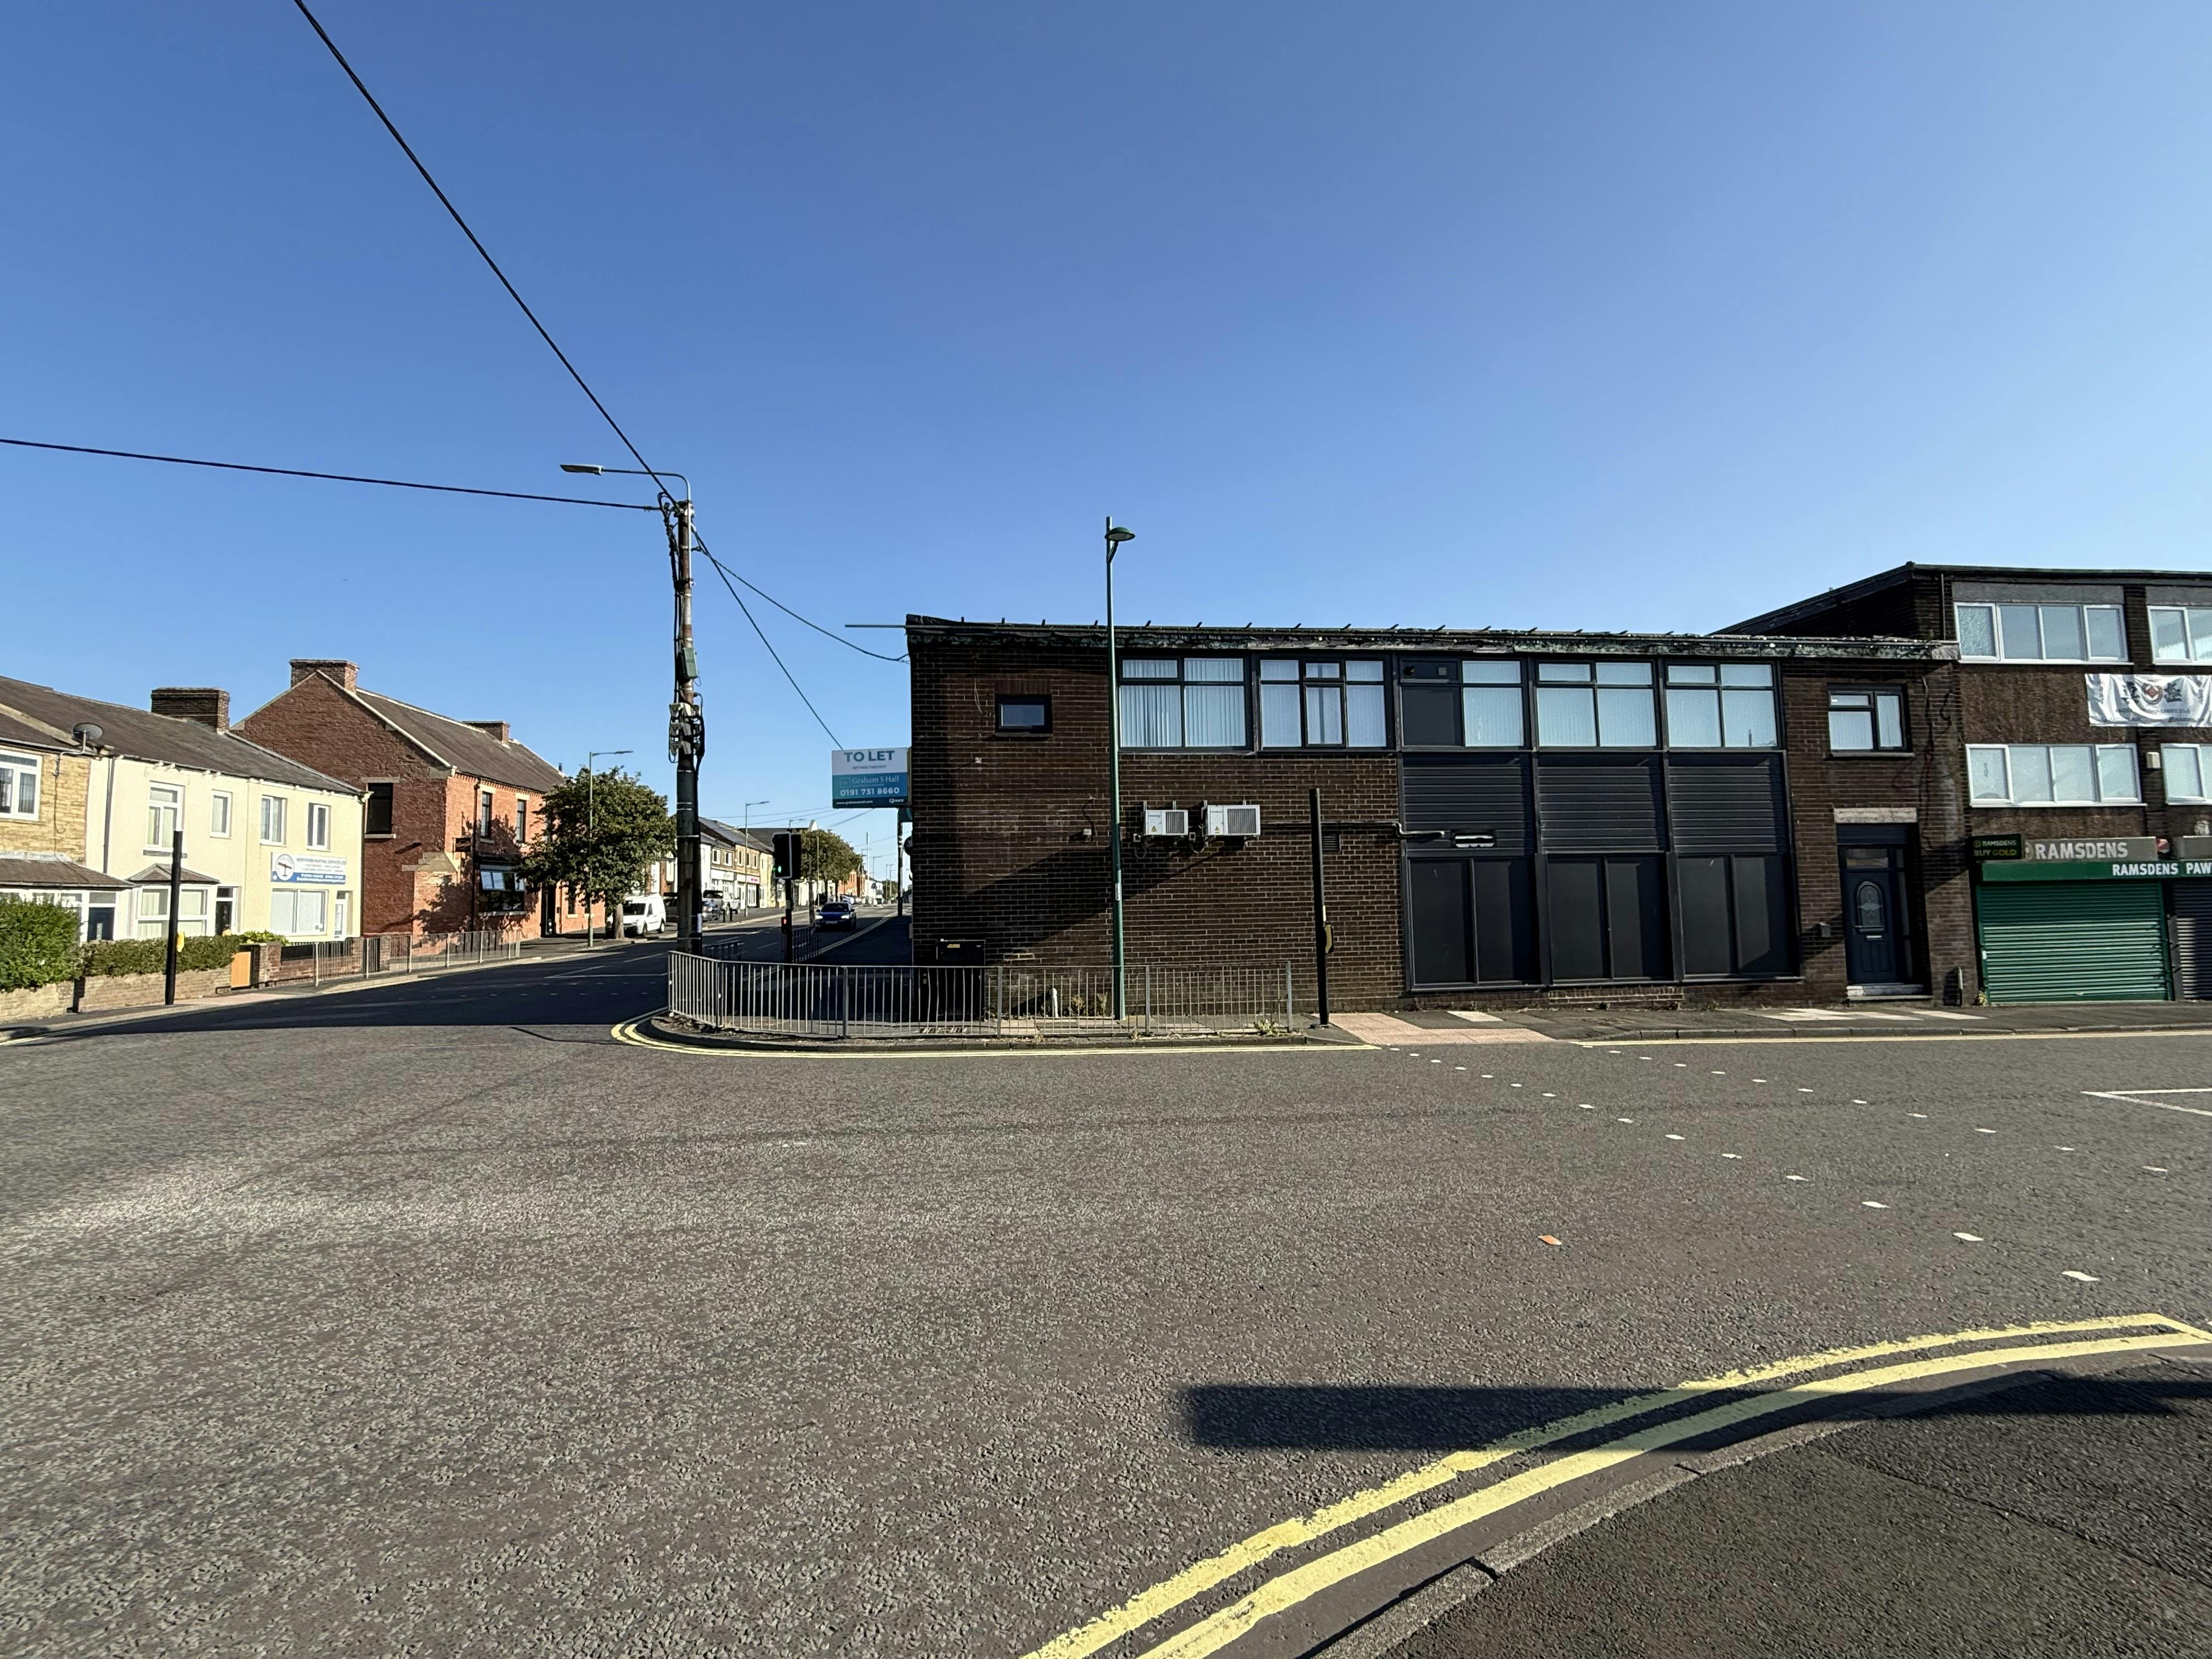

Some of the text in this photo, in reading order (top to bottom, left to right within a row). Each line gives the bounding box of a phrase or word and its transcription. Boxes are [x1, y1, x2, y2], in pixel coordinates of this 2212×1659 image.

[844, 750, 895, 763] TO LET
[2035, 842, 2128, 860] RAMSDENS
[2112, 863, 2179, 876] RAMSDENS
